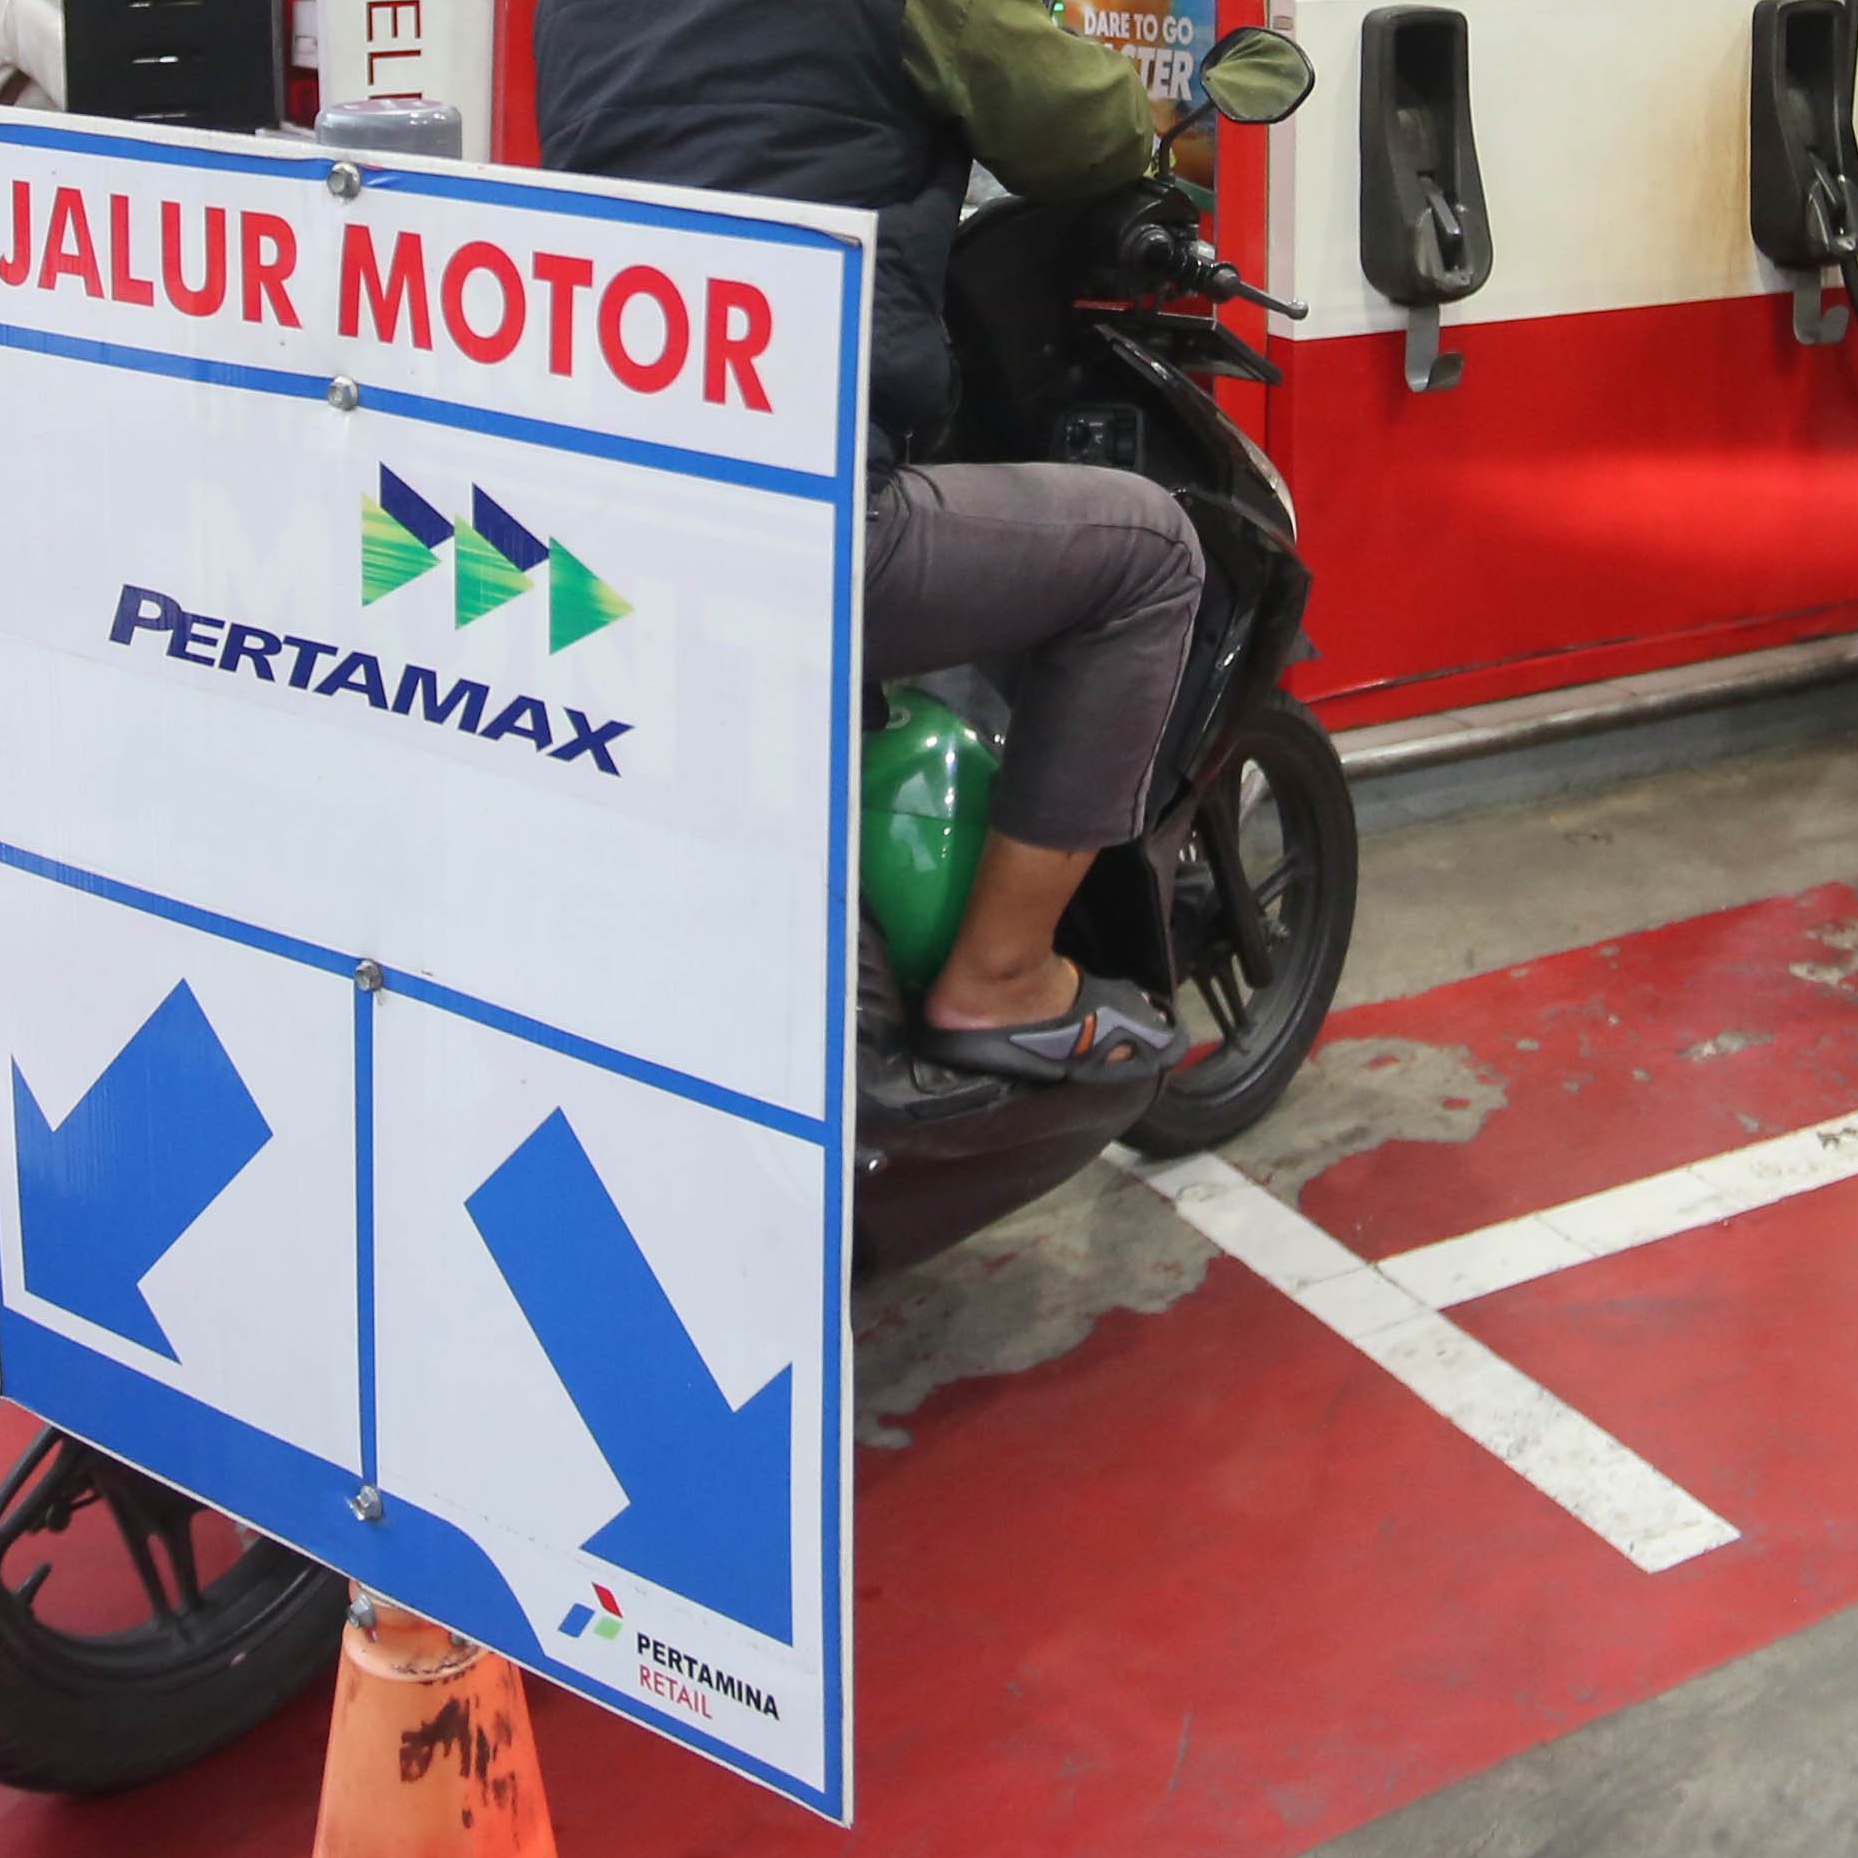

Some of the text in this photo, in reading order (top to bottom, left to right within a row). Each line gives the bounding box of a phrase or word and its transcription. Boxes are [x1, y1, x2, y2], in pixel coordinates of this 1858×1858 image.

[1083, 4, 1194, 45] DARE TO GO
[336, 223, 775, 414] MOTOR
[107, 582, 636, 778] PERTAMAX
[636, 1631, 781, 1722] PERTAMINA
[638, 1663, 714, 1721] RETAIL
